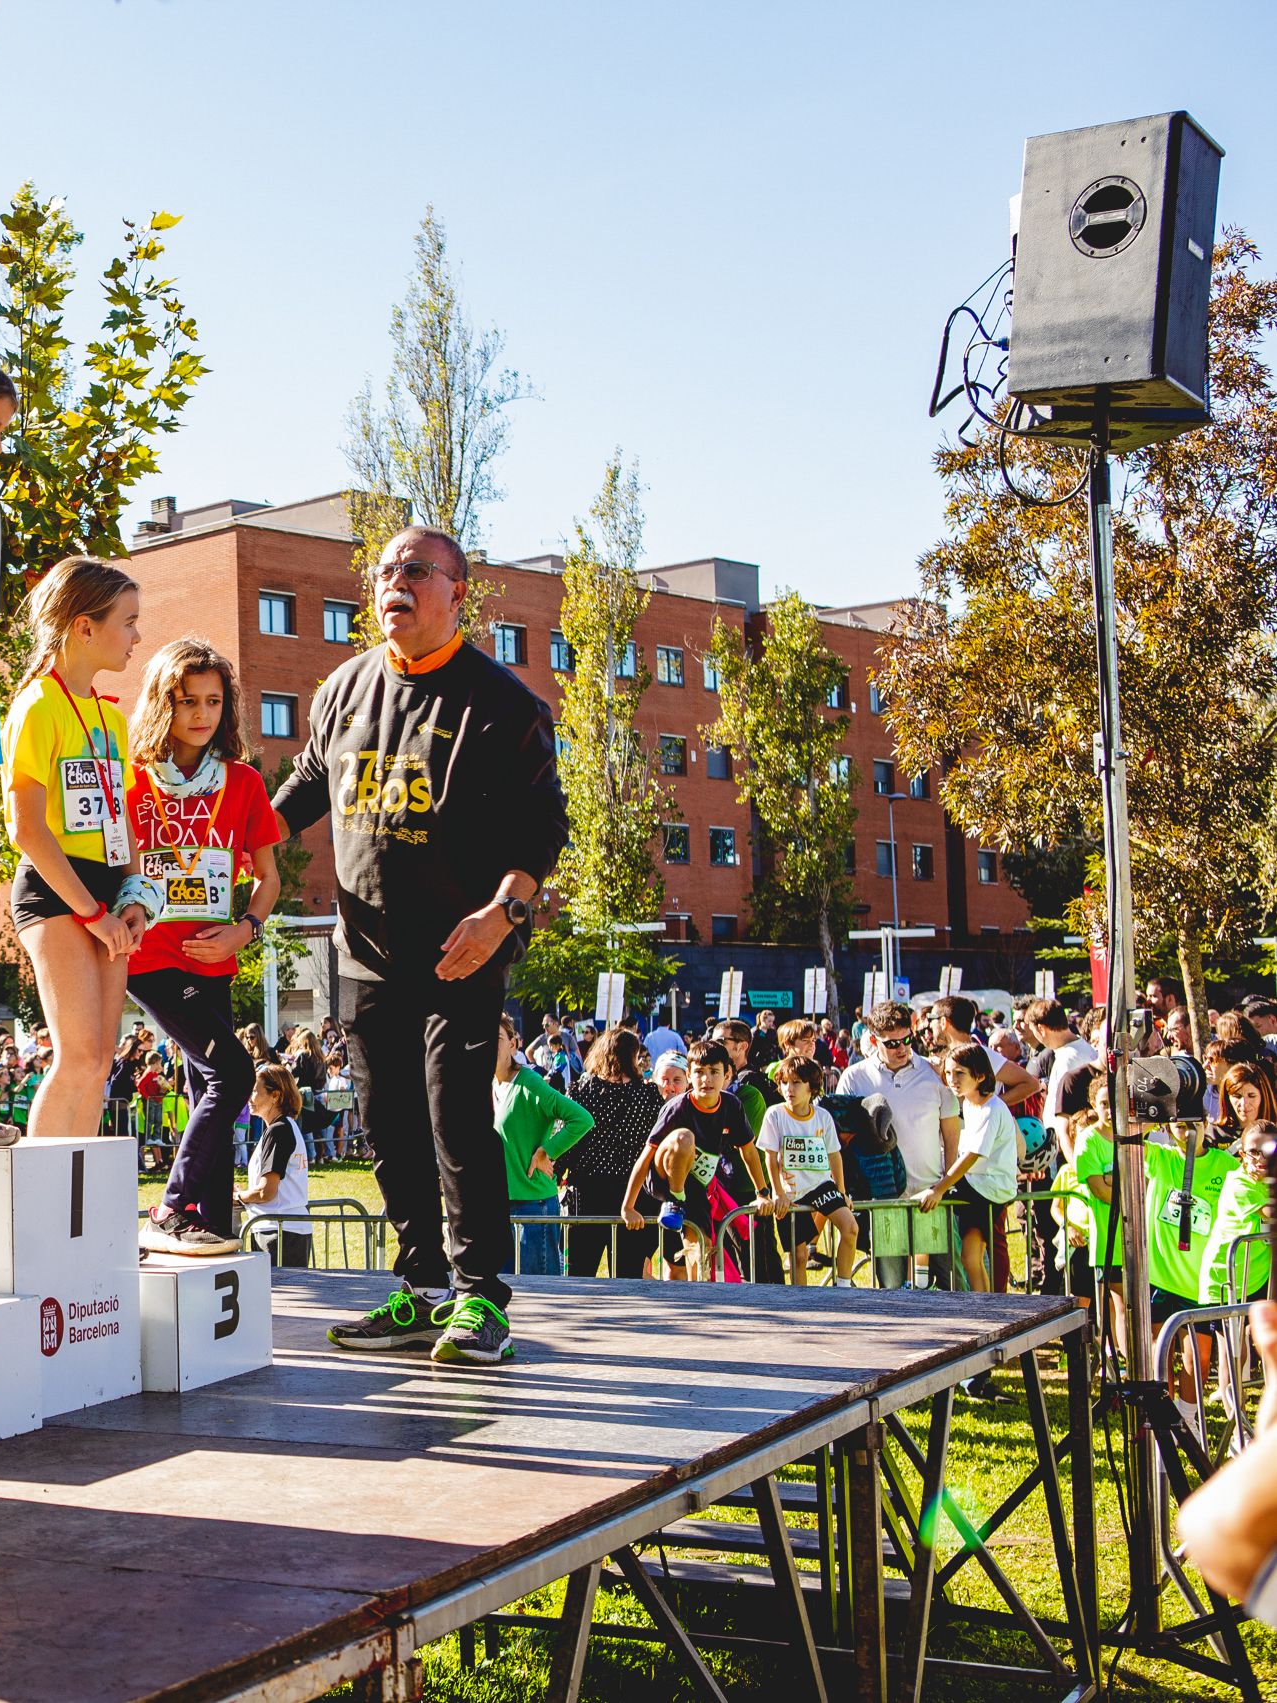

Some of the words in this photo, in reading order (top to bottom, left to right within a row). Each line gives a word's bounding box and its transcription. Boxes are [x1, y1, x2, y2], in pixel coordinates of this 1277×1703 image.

[67, 771, 97, 785] CROS
[337, 777, 431, 816] CROS
[168, 886, 206, 900] CROS
[788, 1153, 824, 1163] 2898
[68, 1294, 120, 1322] Diputació
[214, 1269, 240, 1340] 3
[69, 1320, 120, 1345] Barcelona
